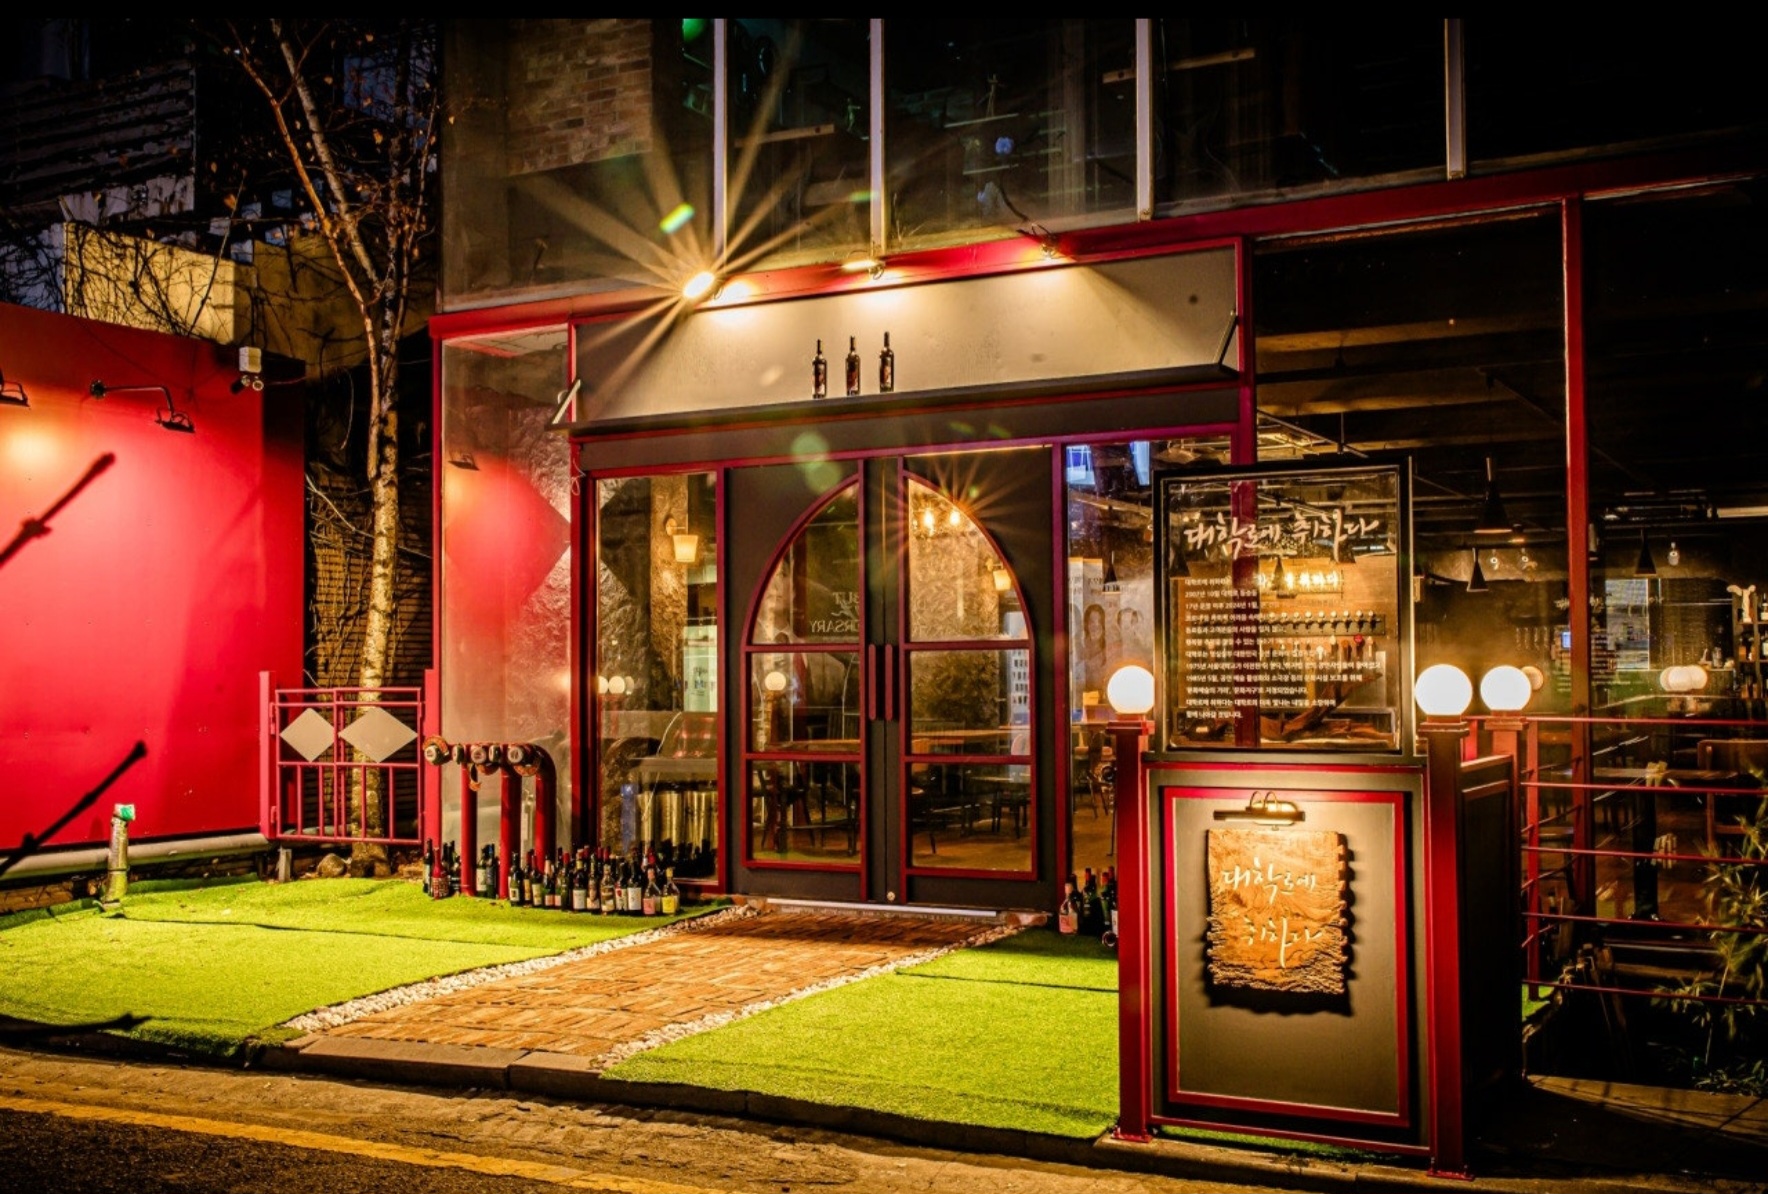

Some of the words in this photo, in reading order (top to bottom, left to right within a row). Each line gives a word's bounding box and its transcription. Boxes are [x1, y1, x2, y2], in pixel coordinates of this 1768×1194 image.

[1183, 512, 1281, 560] 대학로에
[1291, 509, 1380, 563] 취하다
[1222, 856, 1319, 905] 대학로에
[1241, 916, 1324, 969] 취하다
